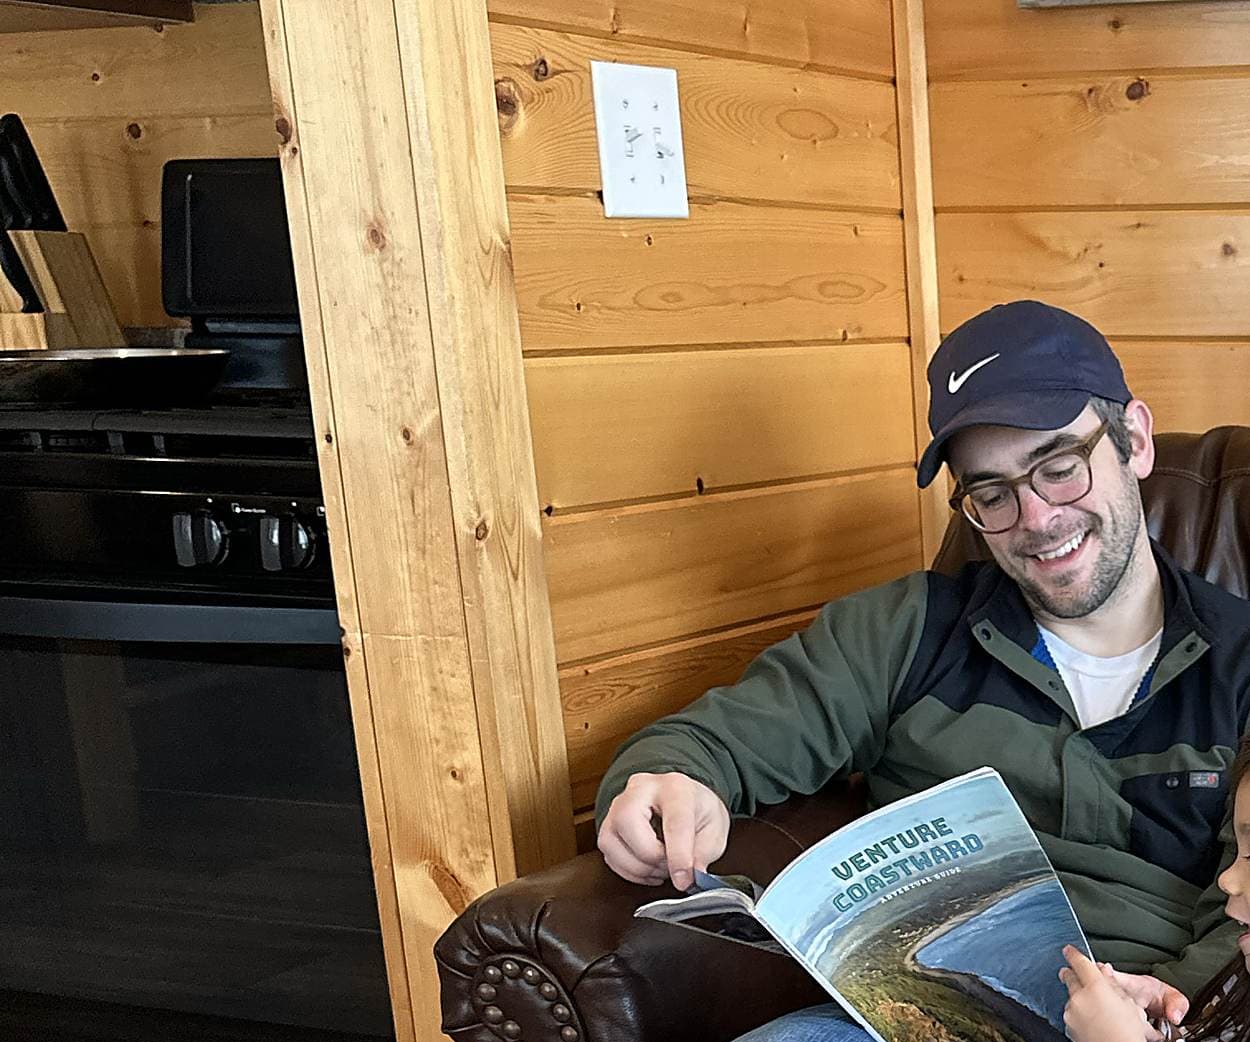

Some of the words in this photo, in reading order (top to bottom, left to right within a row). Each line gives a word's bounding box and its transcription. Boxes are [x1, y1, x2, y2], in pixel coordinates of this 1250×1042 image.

[832, 817, 953, 881] VENTURE
[832, 833, 984, 912] COASTWARD
[881, 876, 932, 903] ADVENTURE
